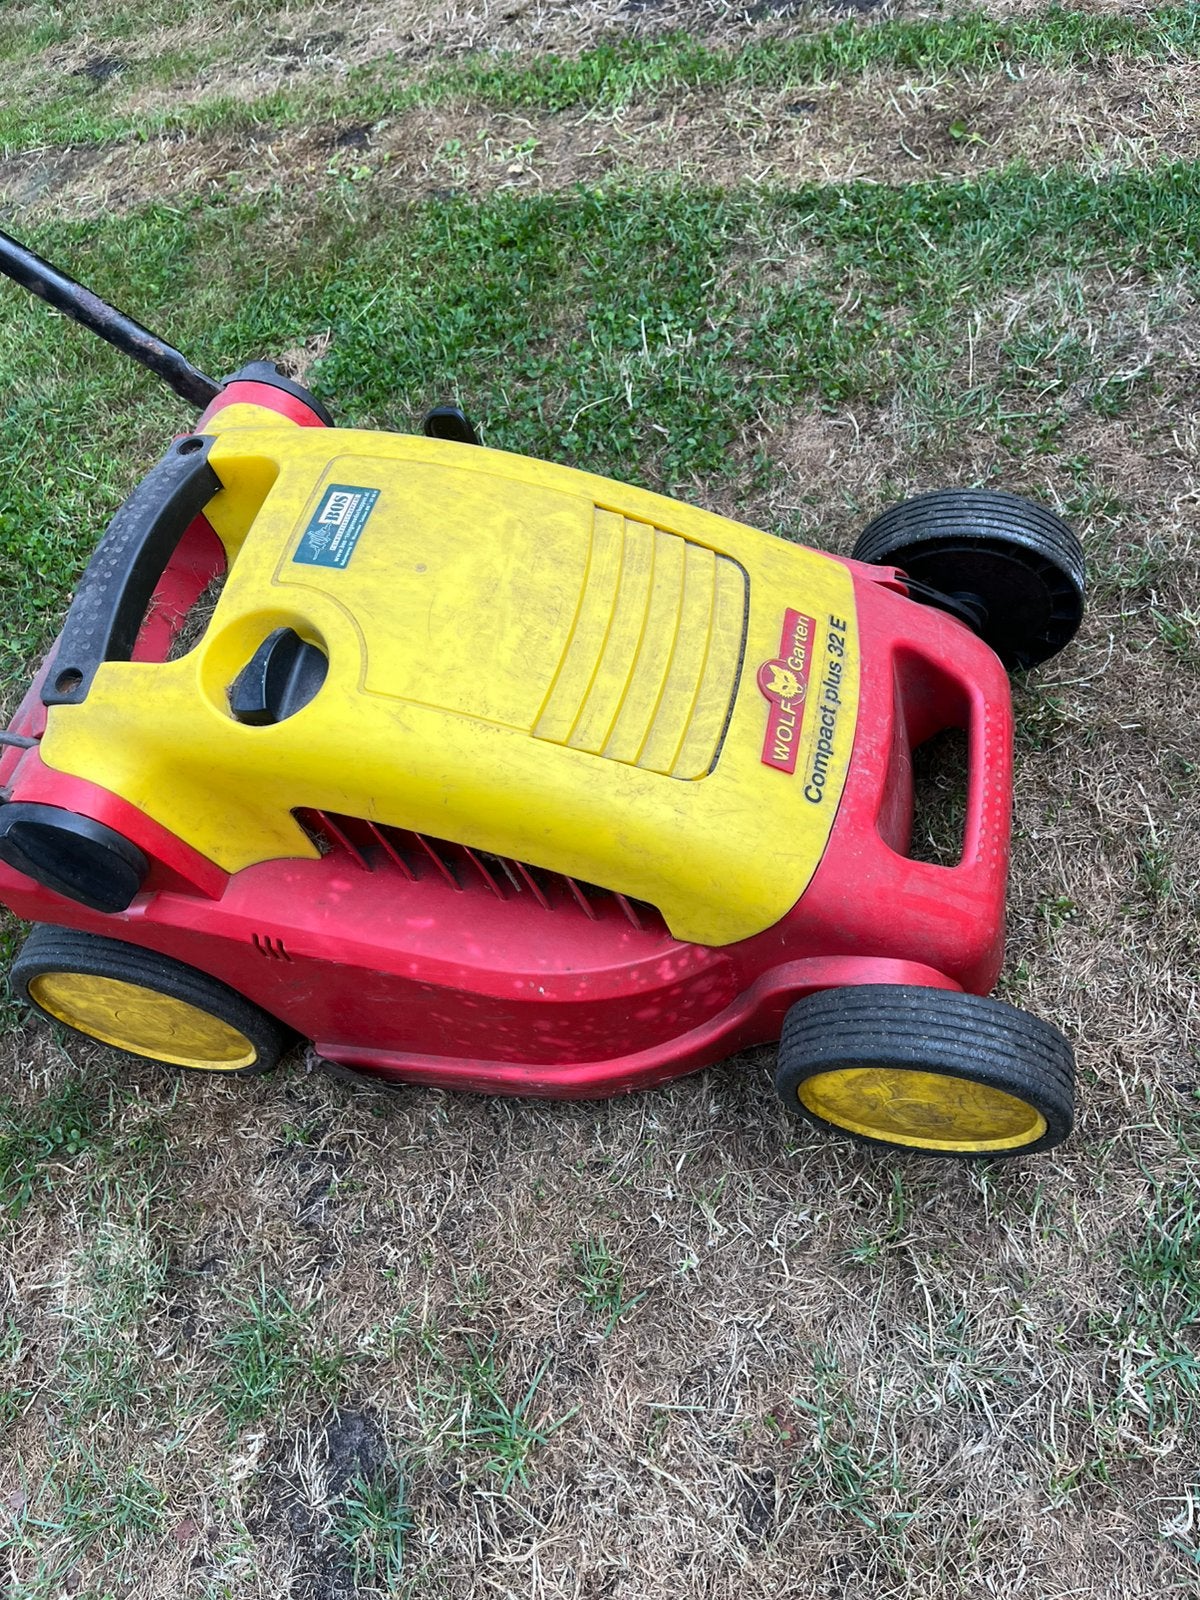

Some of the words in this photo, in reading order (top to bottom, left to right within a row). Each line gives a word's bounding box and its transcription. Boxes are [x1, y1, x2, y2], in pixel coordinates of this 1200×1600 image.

[325, 495, 348, 521] BOS
[830, 614, 847, 632] E
[828, 632, 845, 658] 32
[772, 702, 797, 761] WOLF
[787, 615, 809, 671] Garten
[822, 660, 843, 705] plus
[804, 703, 836, 804] Compact
